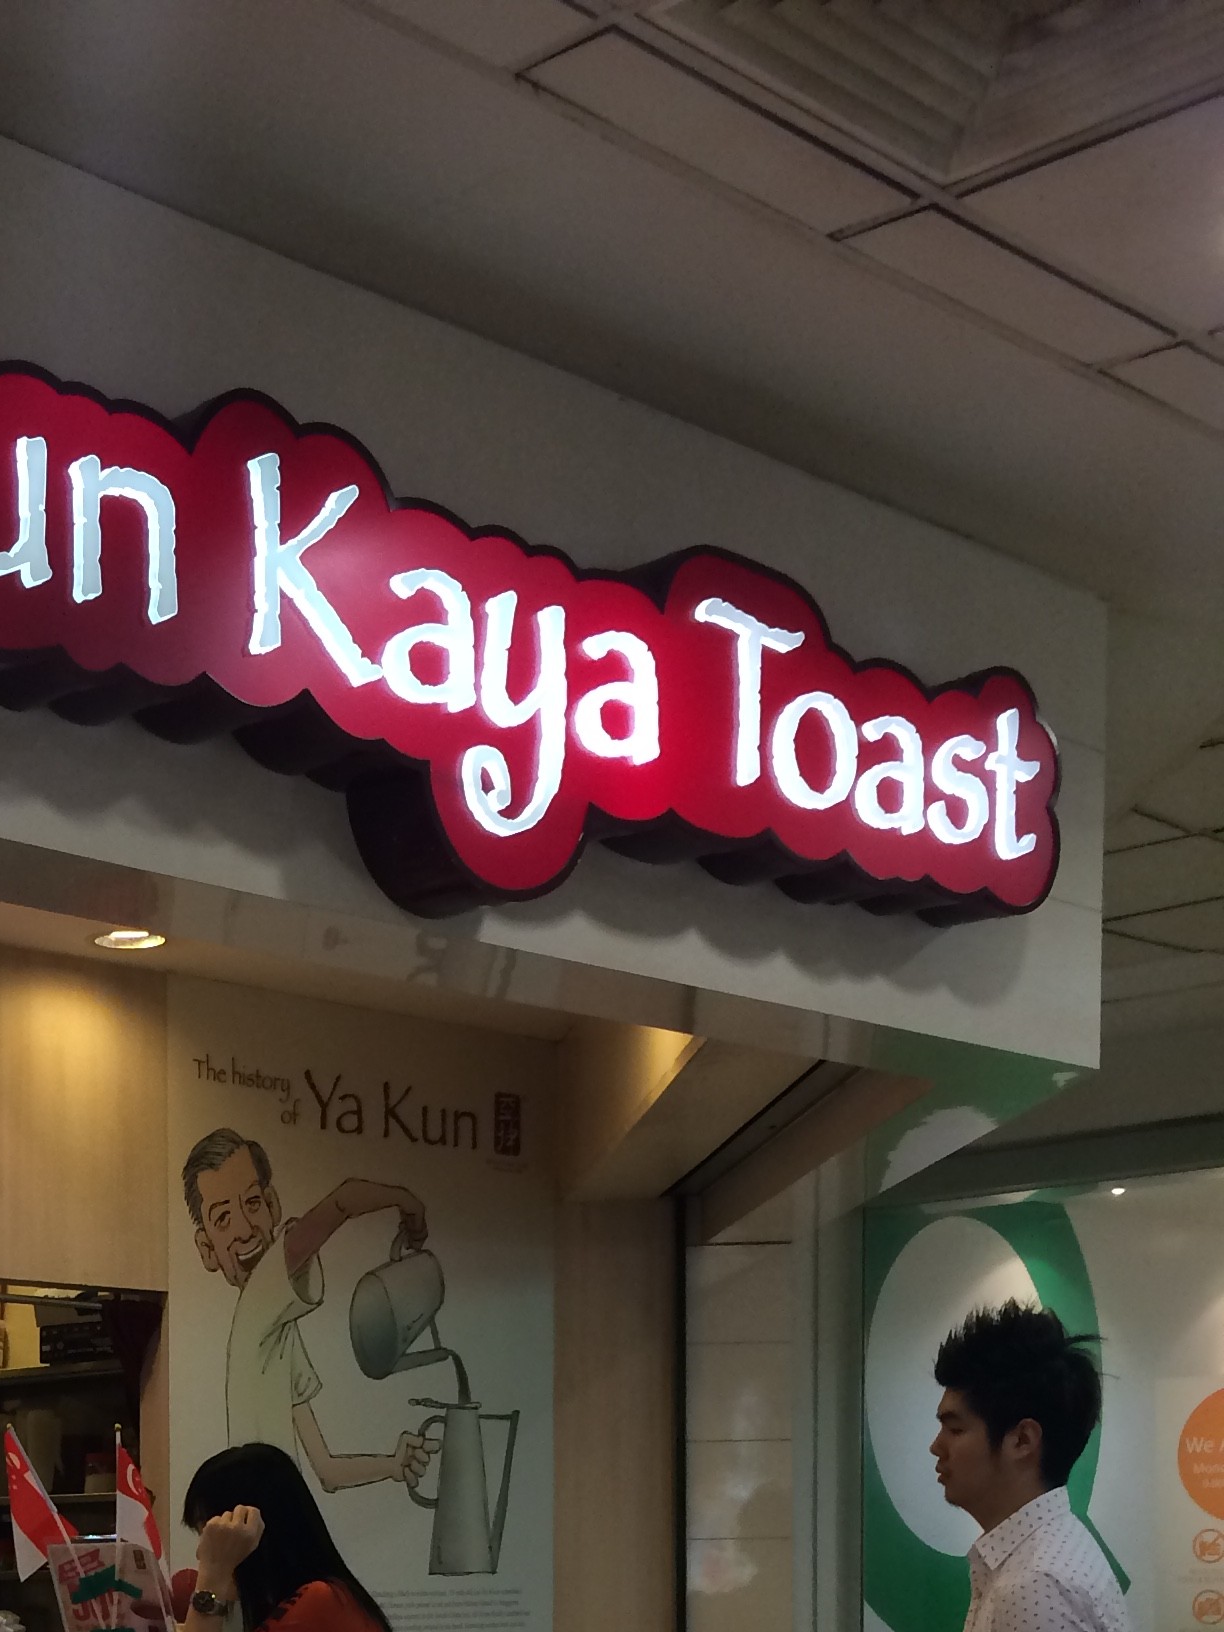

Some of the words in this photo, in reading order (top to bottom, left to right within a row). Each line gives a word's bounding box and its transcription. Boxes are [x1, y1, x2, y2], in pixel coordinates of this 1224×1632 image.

[245, 452, 661, 837] Kaya
[694, 596, 1040, 861] Toast
[192, 1053, 226, 1083] The
[231, 1057, 291, 1103] history
[280, 1099, 301, 1125] of
[304, 1069, 364, 1135] Ya
[382, 1081, 478, 1150] Kun
[1186, 1437, 1215, 1454] We
